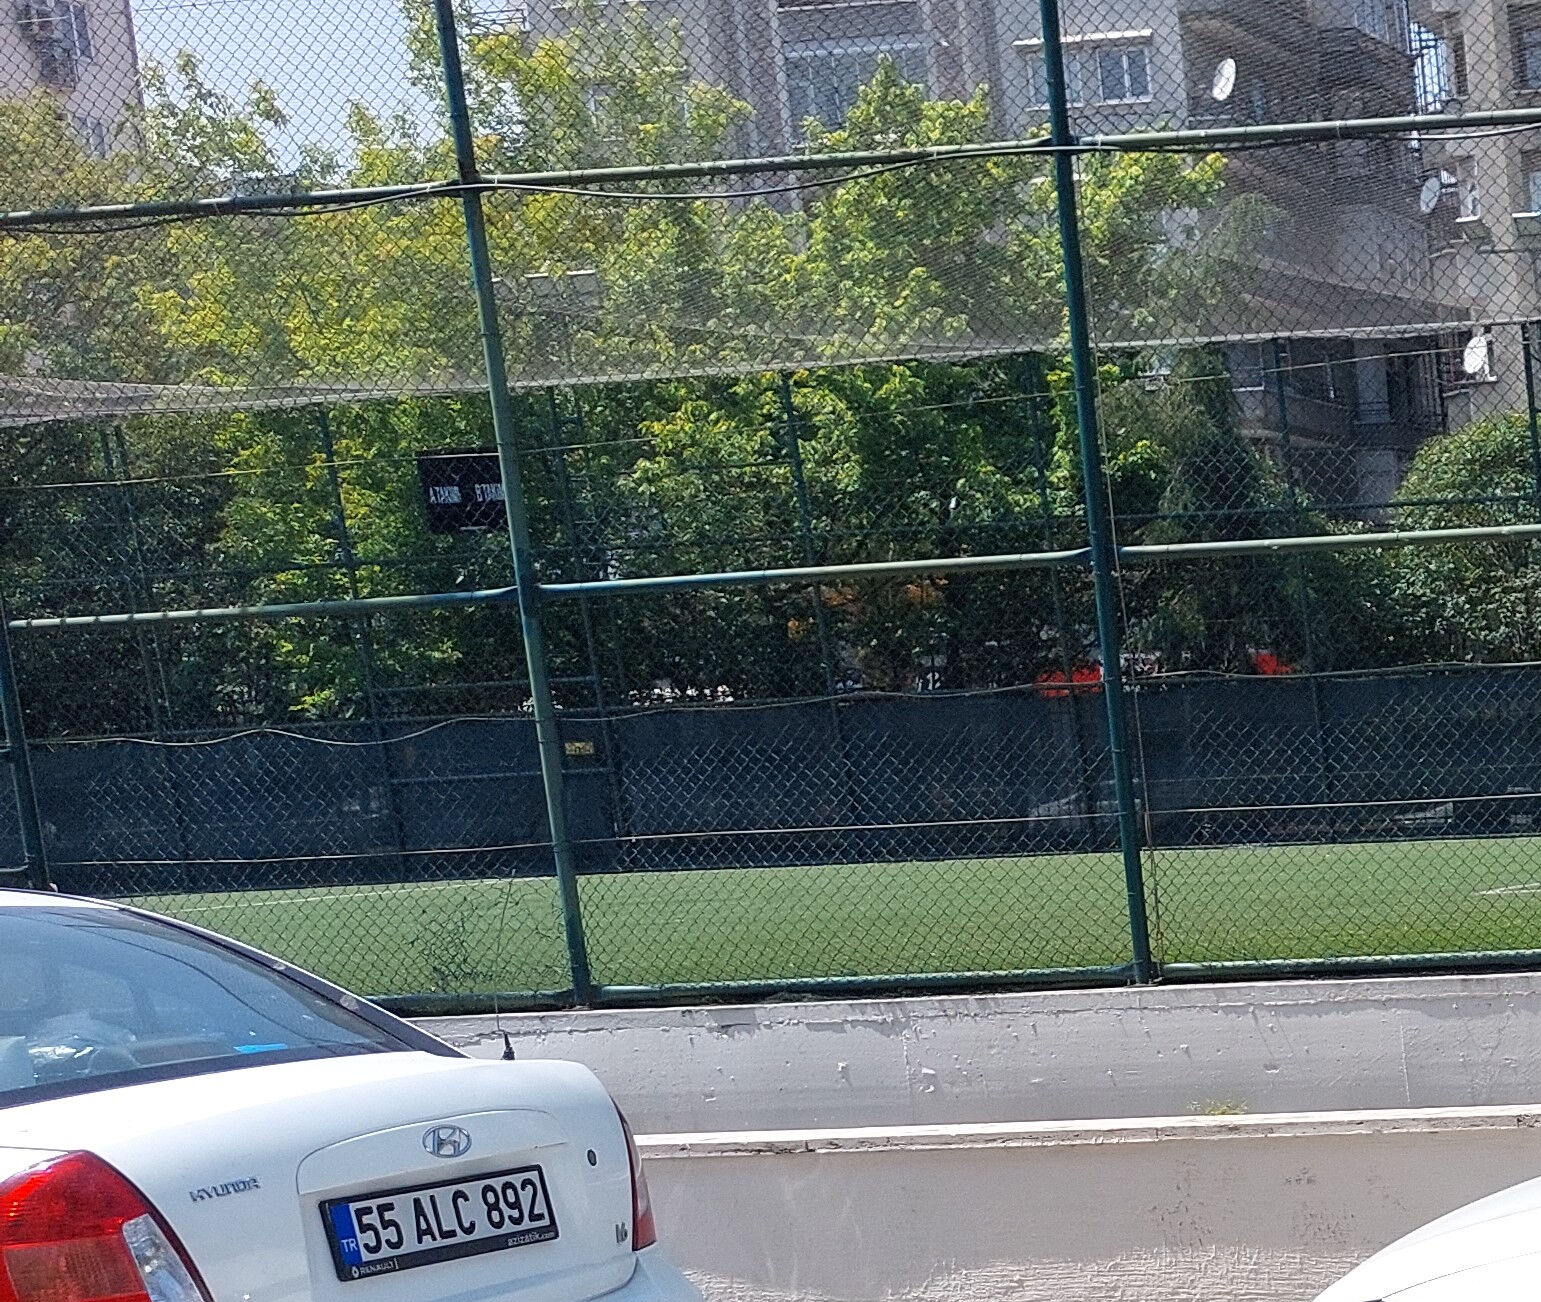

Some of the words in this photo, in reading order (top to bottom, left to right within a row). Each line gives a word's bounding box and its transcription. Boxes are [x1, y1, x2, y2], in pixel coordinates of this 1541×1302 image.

[354, 1202, 404, 1254] 55
[413, 1189, 476, 1245] ALC
[481, 1177, 546, 1230] 892
[341, 1238, 358, 1253] TR
